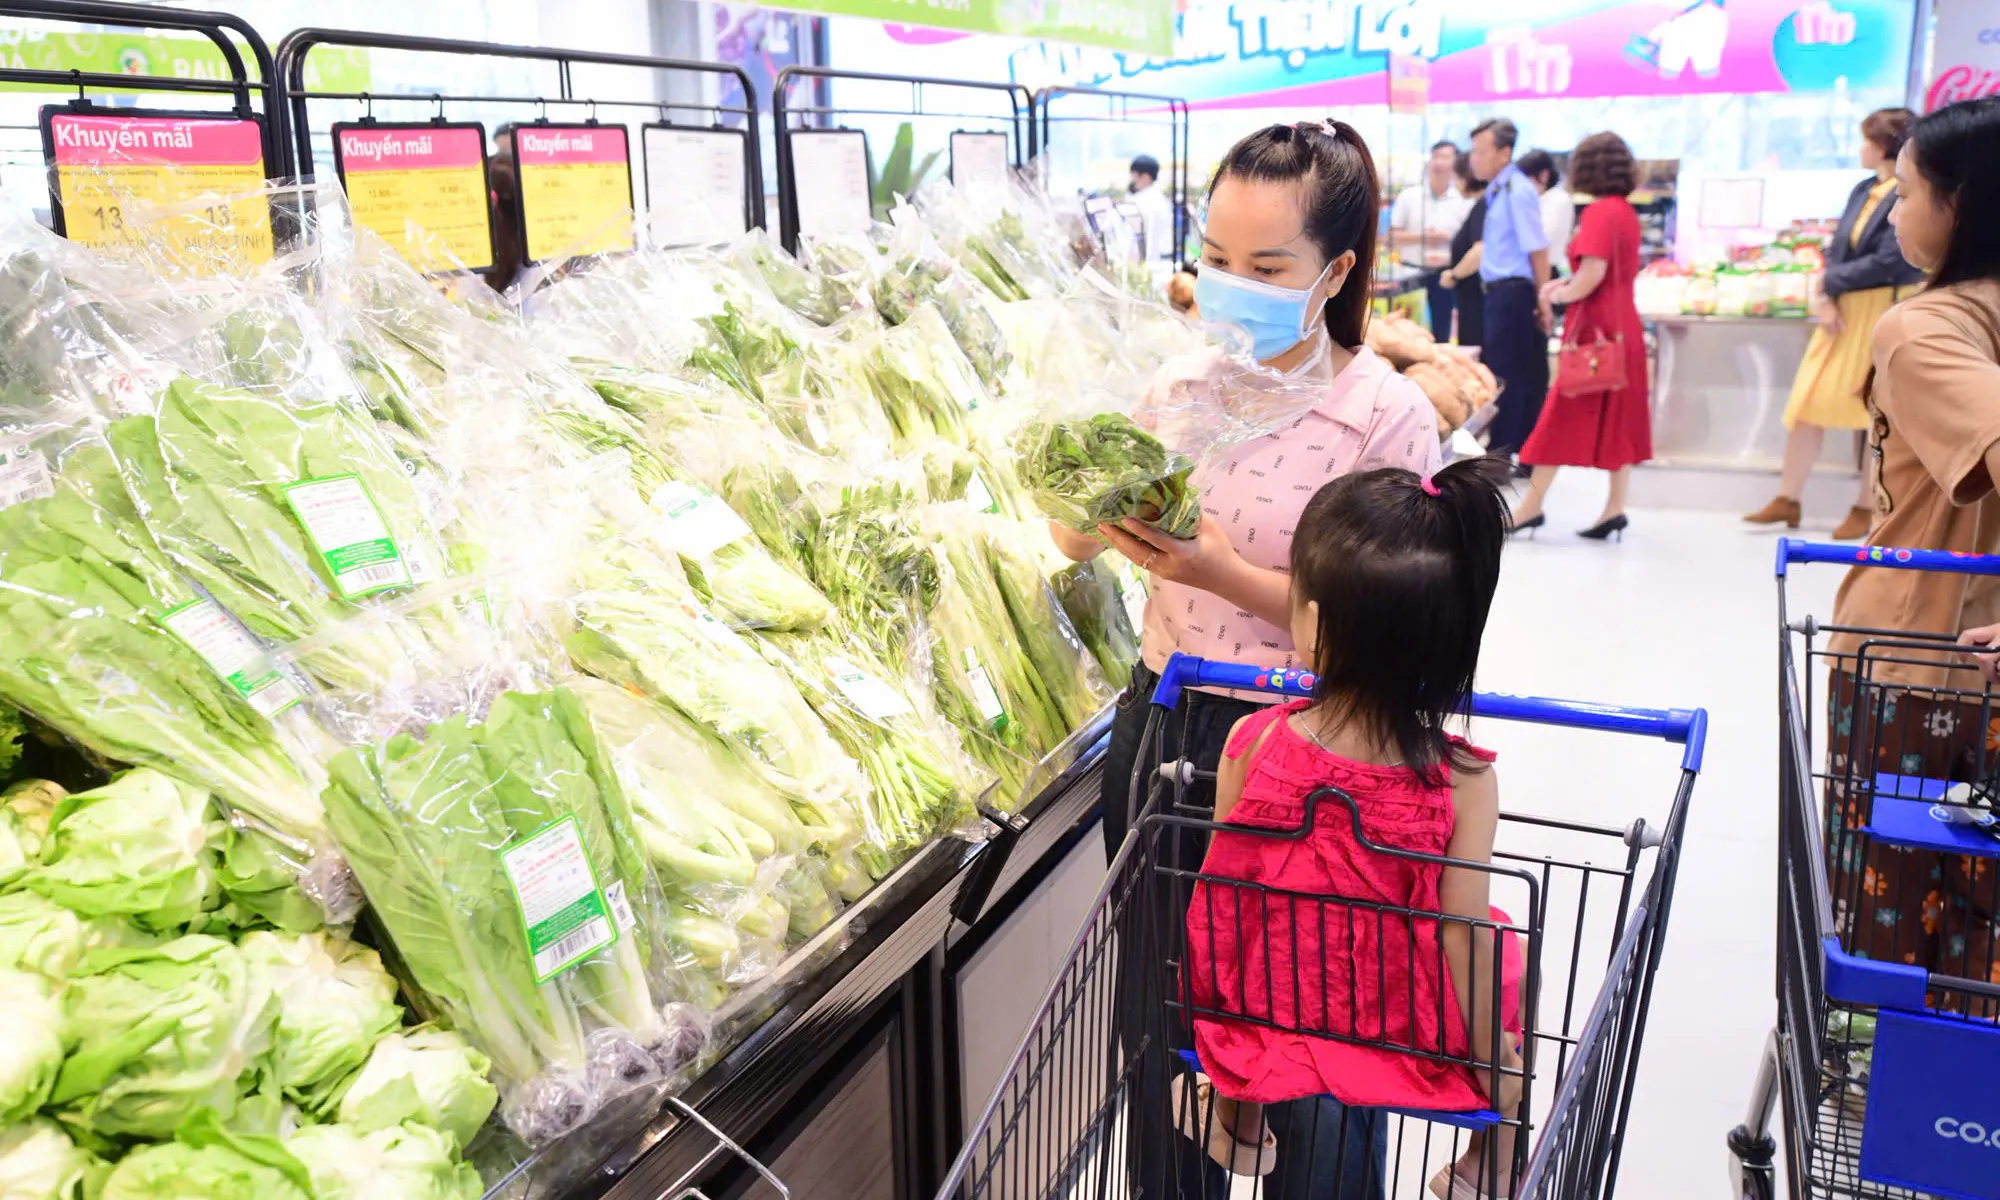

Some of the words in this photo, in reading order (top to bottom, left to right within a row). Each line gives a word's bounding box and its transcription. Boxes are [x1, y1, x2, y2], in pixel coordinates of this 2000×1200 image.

[55, 122, 149, 153] Khuyến
[153, 126, 193, 149] mãi
[523, 132, 570, 157] Khuyến
[342, 133, 402, 161] Khuyến
[405, 136, 433, 154] mãi
[1274, 454, 1284, 469] FENDI
[1325, 458, 1336, 474] FENDI
[1249, 469, 1266, 478] FENDI
[1256, 496, 1272, 504] FENDI
[1204, 507, 1220, 516] FENDI
[1188, 624, 1204, 634] FENDI
[1218, 625, 1226, 640] FENDI
[1234, 642, 1242, 656] FENDI
[1261, 640, 1280, 648] FENDI
